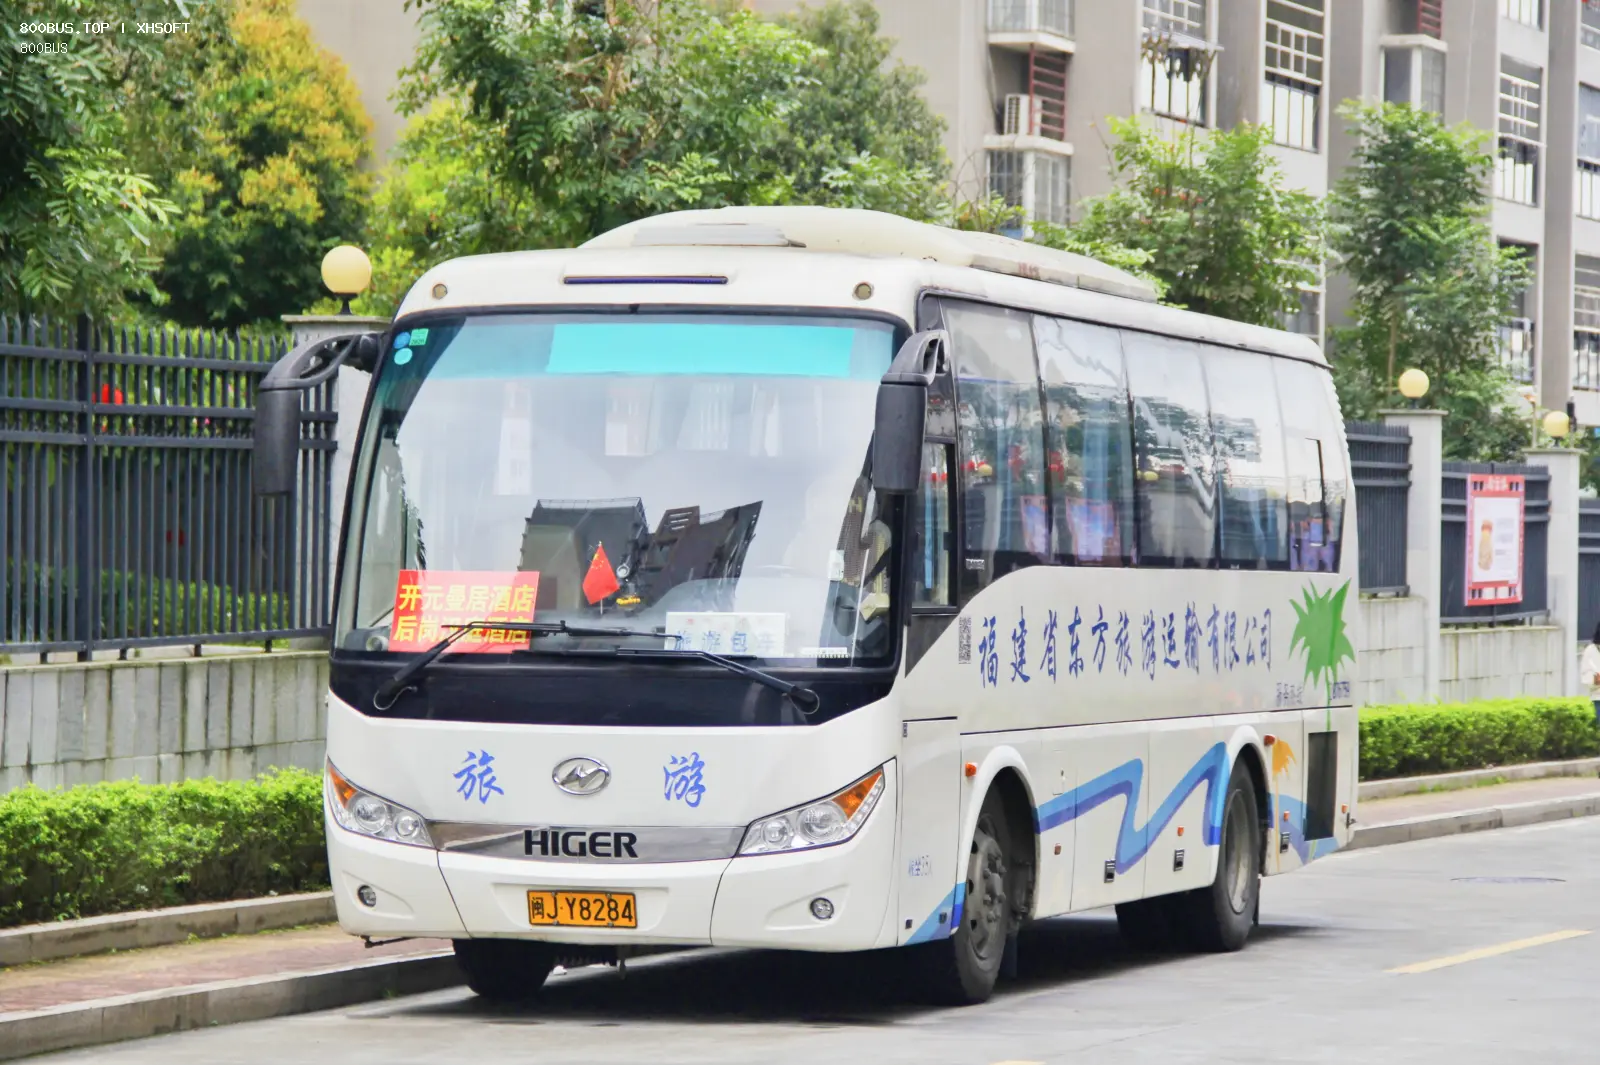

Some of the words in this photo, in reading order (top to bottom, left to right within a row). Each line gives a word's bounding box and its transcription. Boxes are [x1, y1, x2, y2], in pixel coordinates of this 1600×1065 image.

[399, 584, 535, 613] 开元曼居酒店
[978, 601, 1272, 689] 福建省东方旅游运输有限公司
[452, 749, 504, 804] 旅
[663, 752, 706, 808] 游
[524, 829, 639, 859] HIGER
